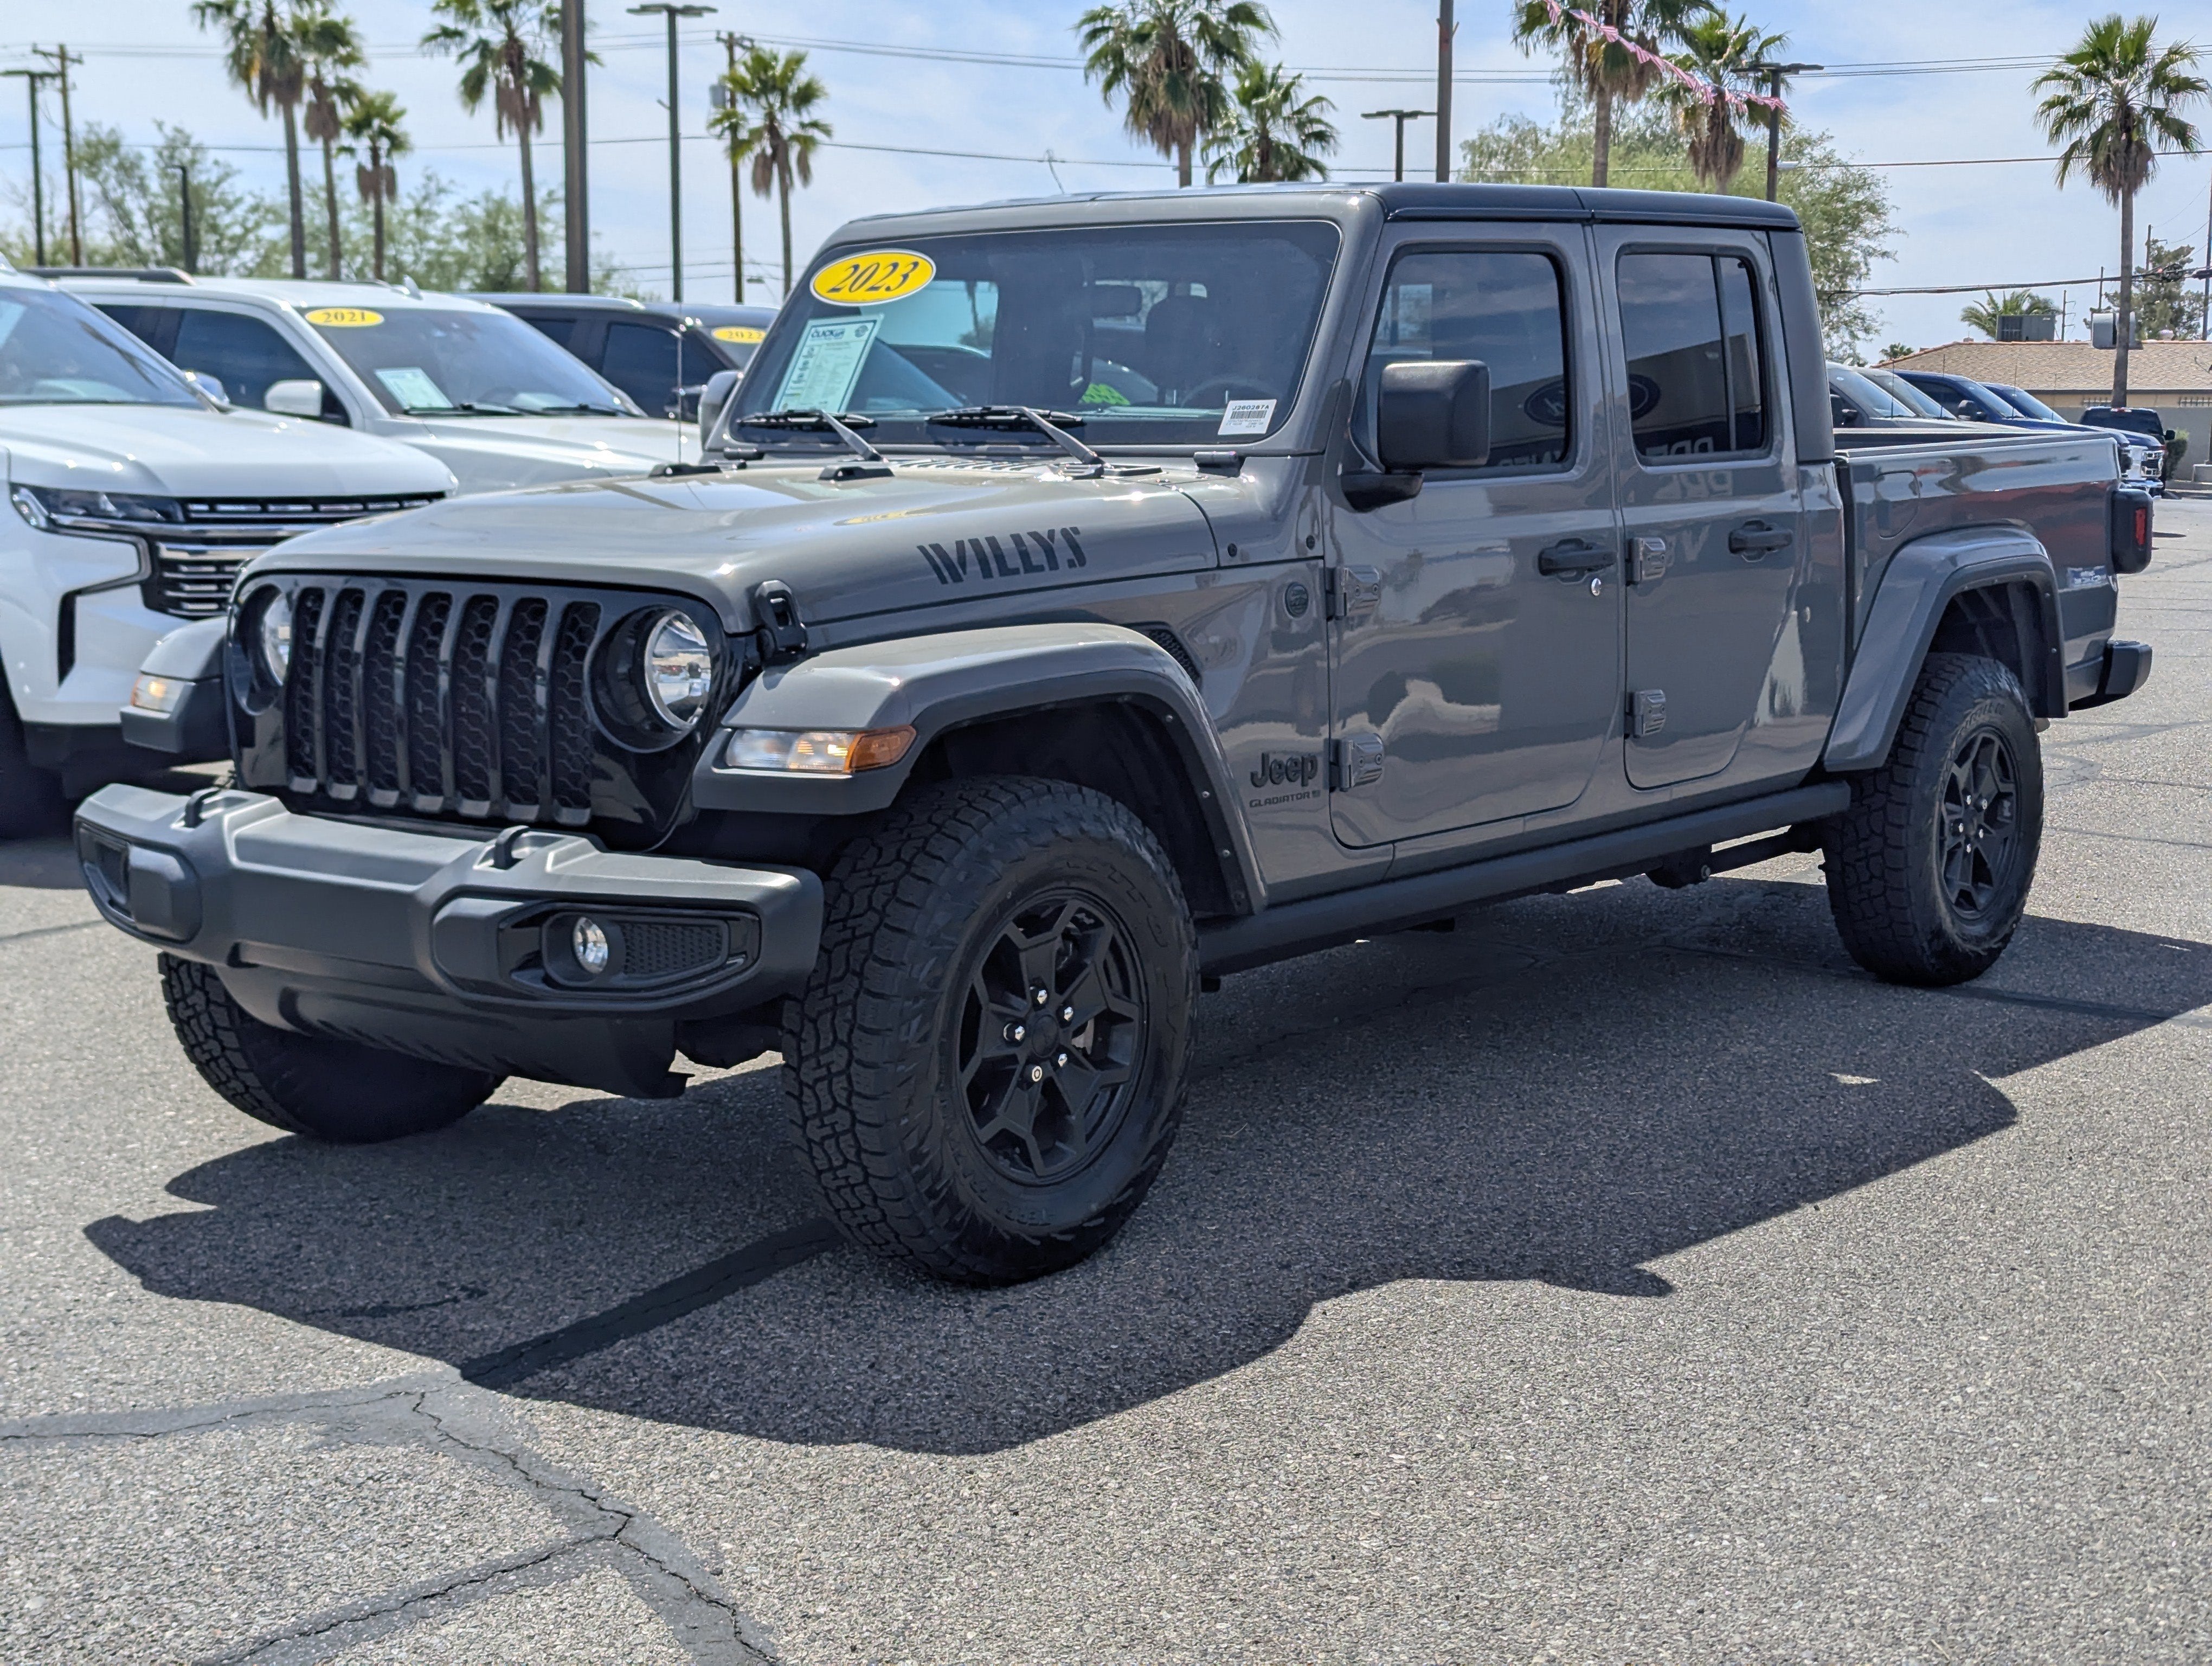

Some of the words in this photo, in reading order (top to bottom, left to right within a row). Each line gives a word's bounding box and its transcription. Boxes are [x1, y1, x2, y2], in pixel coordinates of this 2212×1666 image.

[826, 261, 919, 293] 2023
[322, 311, 365, 322] 2021
[728, 331, 763, 339] 2022
[917, 526, 1087, 585] WILLYS
[1250, 752, 1318, 787] Jeep
[1249, 791, 1310, 808] GLADIATOR
